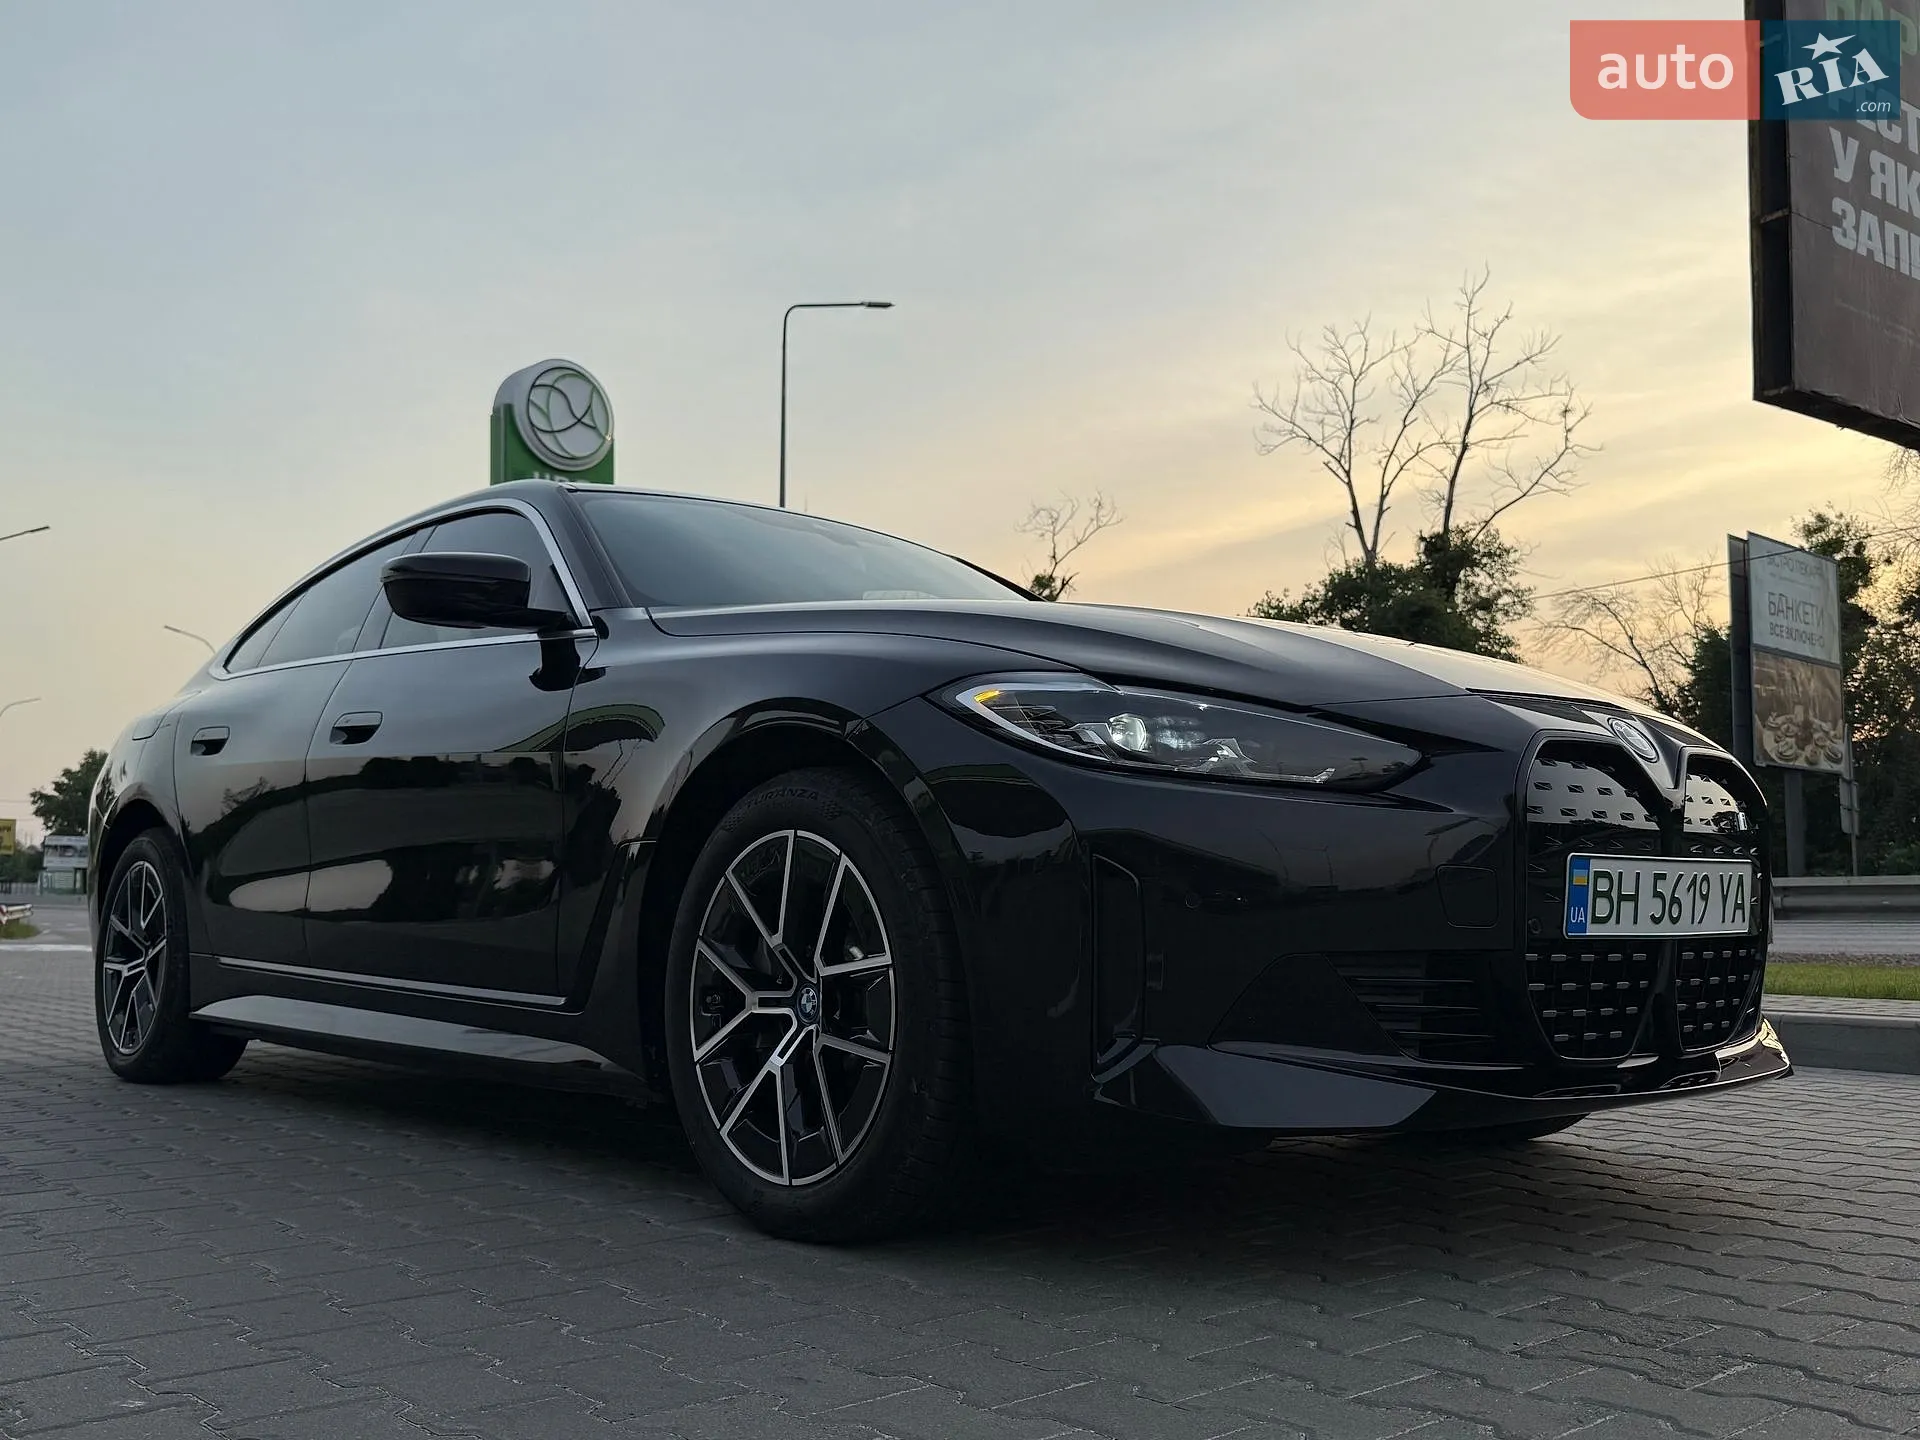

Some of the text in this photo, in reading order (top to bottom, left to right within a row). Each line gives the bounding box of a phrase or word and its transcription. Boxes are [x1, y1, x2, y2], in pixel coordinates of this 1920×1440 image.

[1829, 126, 1859, 183] У
[1767, 591, 1825, 628] БАНКЕТИ
[1570, 869, 1746, 925] UA BH 5619 YA
